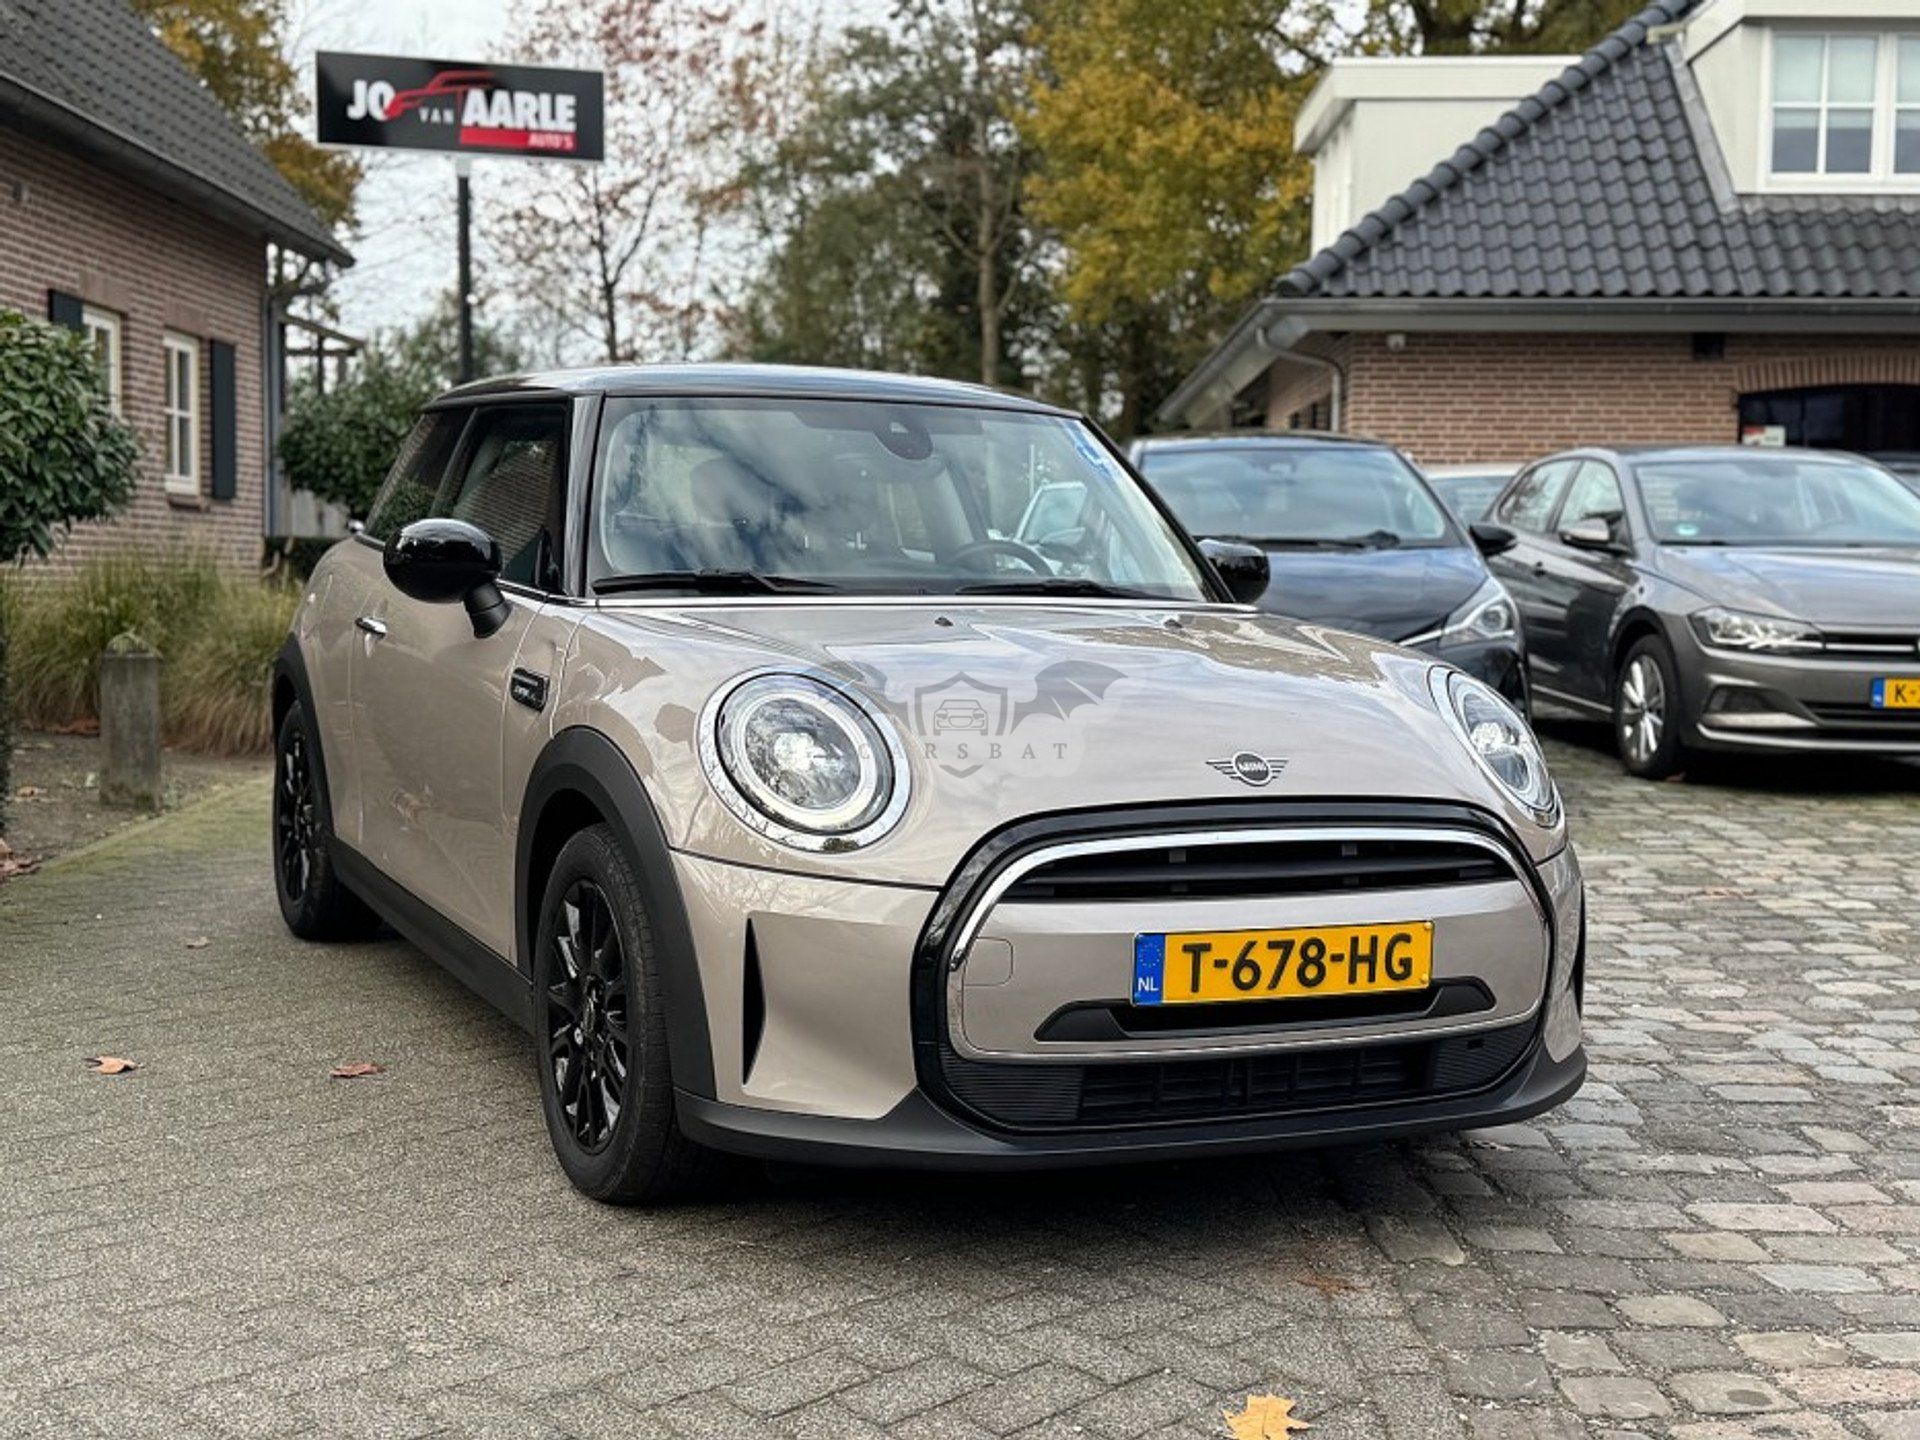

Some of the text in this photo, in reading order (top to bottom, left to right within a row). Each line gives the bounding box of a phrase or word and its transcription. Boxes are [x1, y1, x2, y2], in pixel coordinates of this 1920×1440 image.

[347, 79, 577, 132] JO VAN AARLE
[1894, 683, 1920, 704] K-
[1181, 932, 1413, 993] T-678-HG
[1137, 977, 1159, 992] NL
